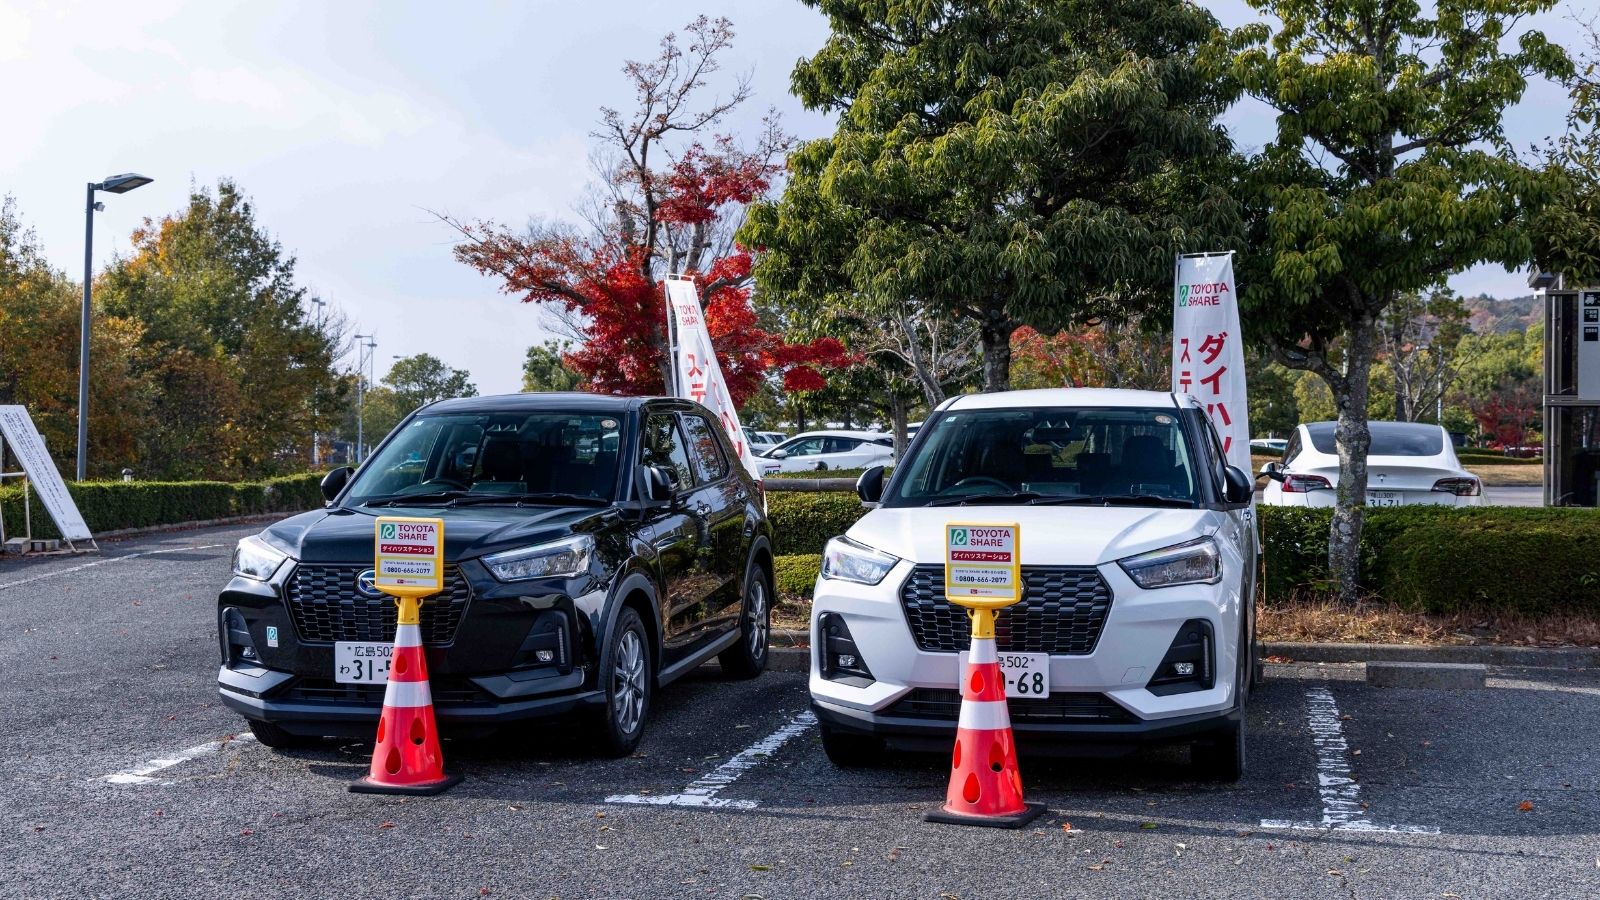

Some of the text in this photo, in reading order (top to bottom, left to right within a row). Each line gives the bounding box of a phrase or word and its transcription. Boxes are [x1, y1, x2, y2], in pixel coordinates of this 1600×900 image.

[1190, 282, 1229, 295] TOYOTA
[1188, 296, 1220, 306] SHARE
[397, 524, 435, 533] TOYOTA
[398, 533, 428, 541] SHARE
[969, 529, 1011, 538] TOYOTA
[970, 538, 1003, 547] SHARE
[381, 545, 433, 553] ダイハツステーション
[953, 552, 1009, 560] ダイハツステーション
[386, 566, 431, 574] 0800-666-2077
[958, 575, 1007, 583] 0800-666-2077
